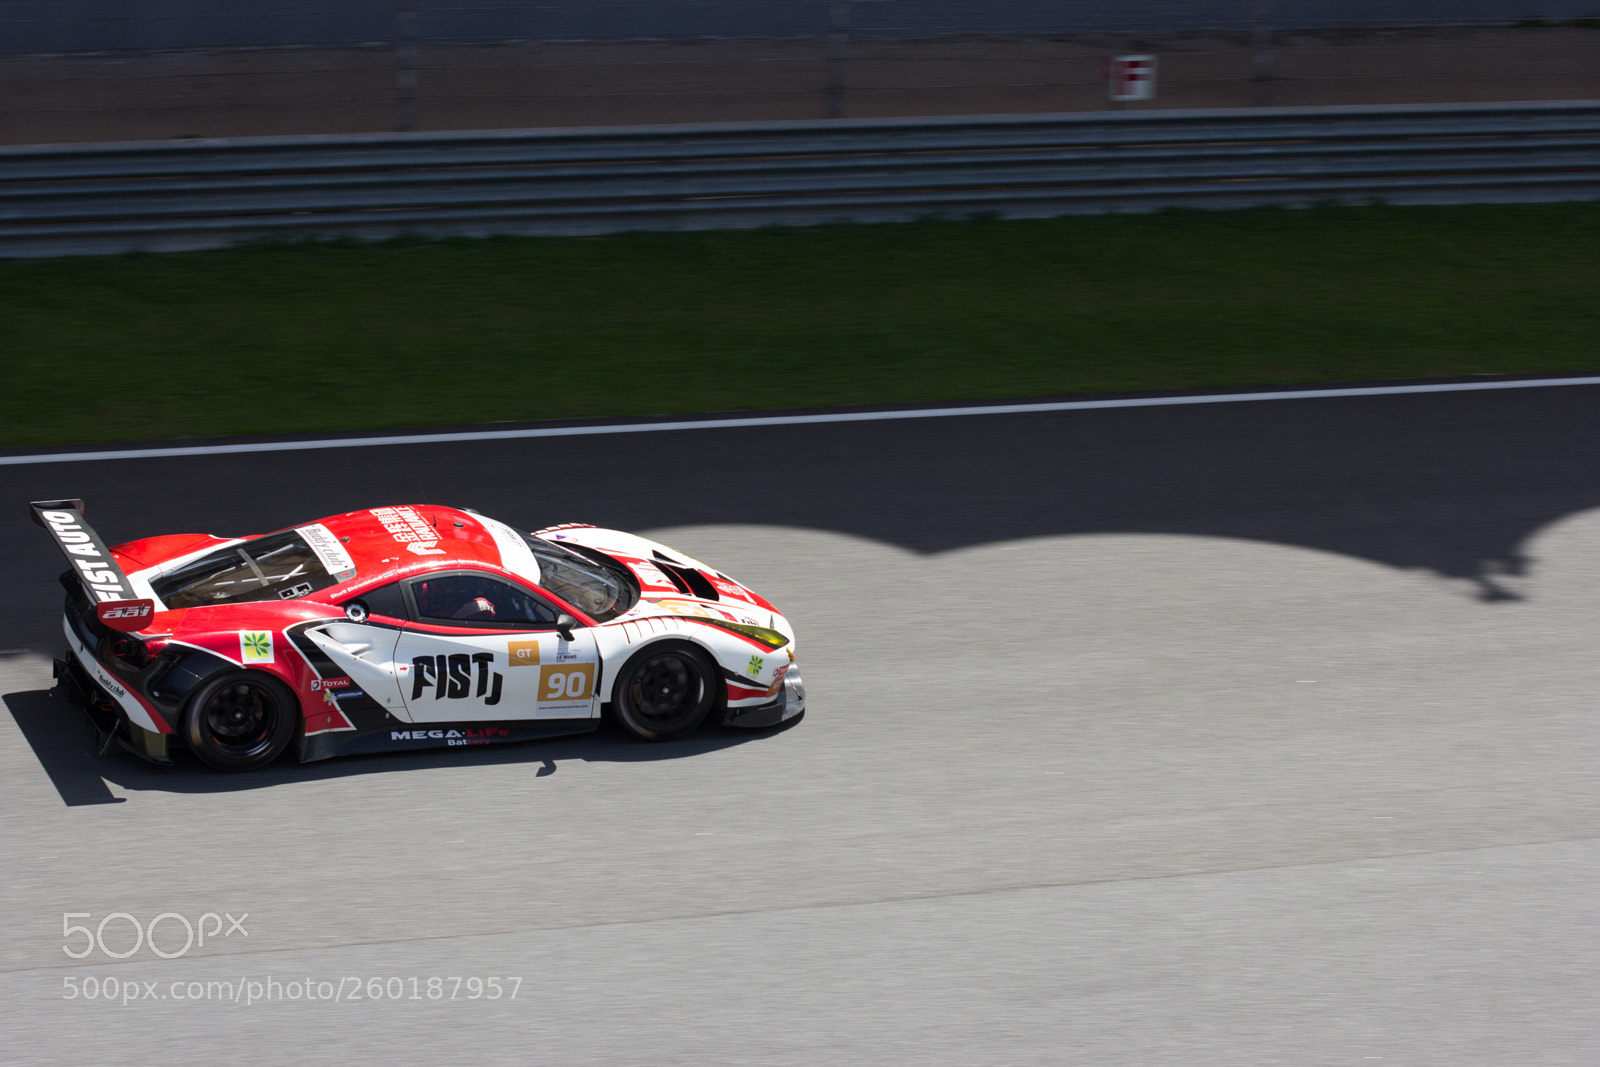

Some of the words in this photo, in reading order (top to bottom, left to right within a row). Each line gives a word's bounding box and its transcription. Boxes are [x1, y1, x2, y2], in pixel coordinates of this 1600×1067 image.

[1113, 61, 1153, 95] F
[42, 511, 102, 556] AUTO
[75, 559, 124, 601] FIST
[516, 648, 532, 658] GT
[546, 671, 586, 699] 90
